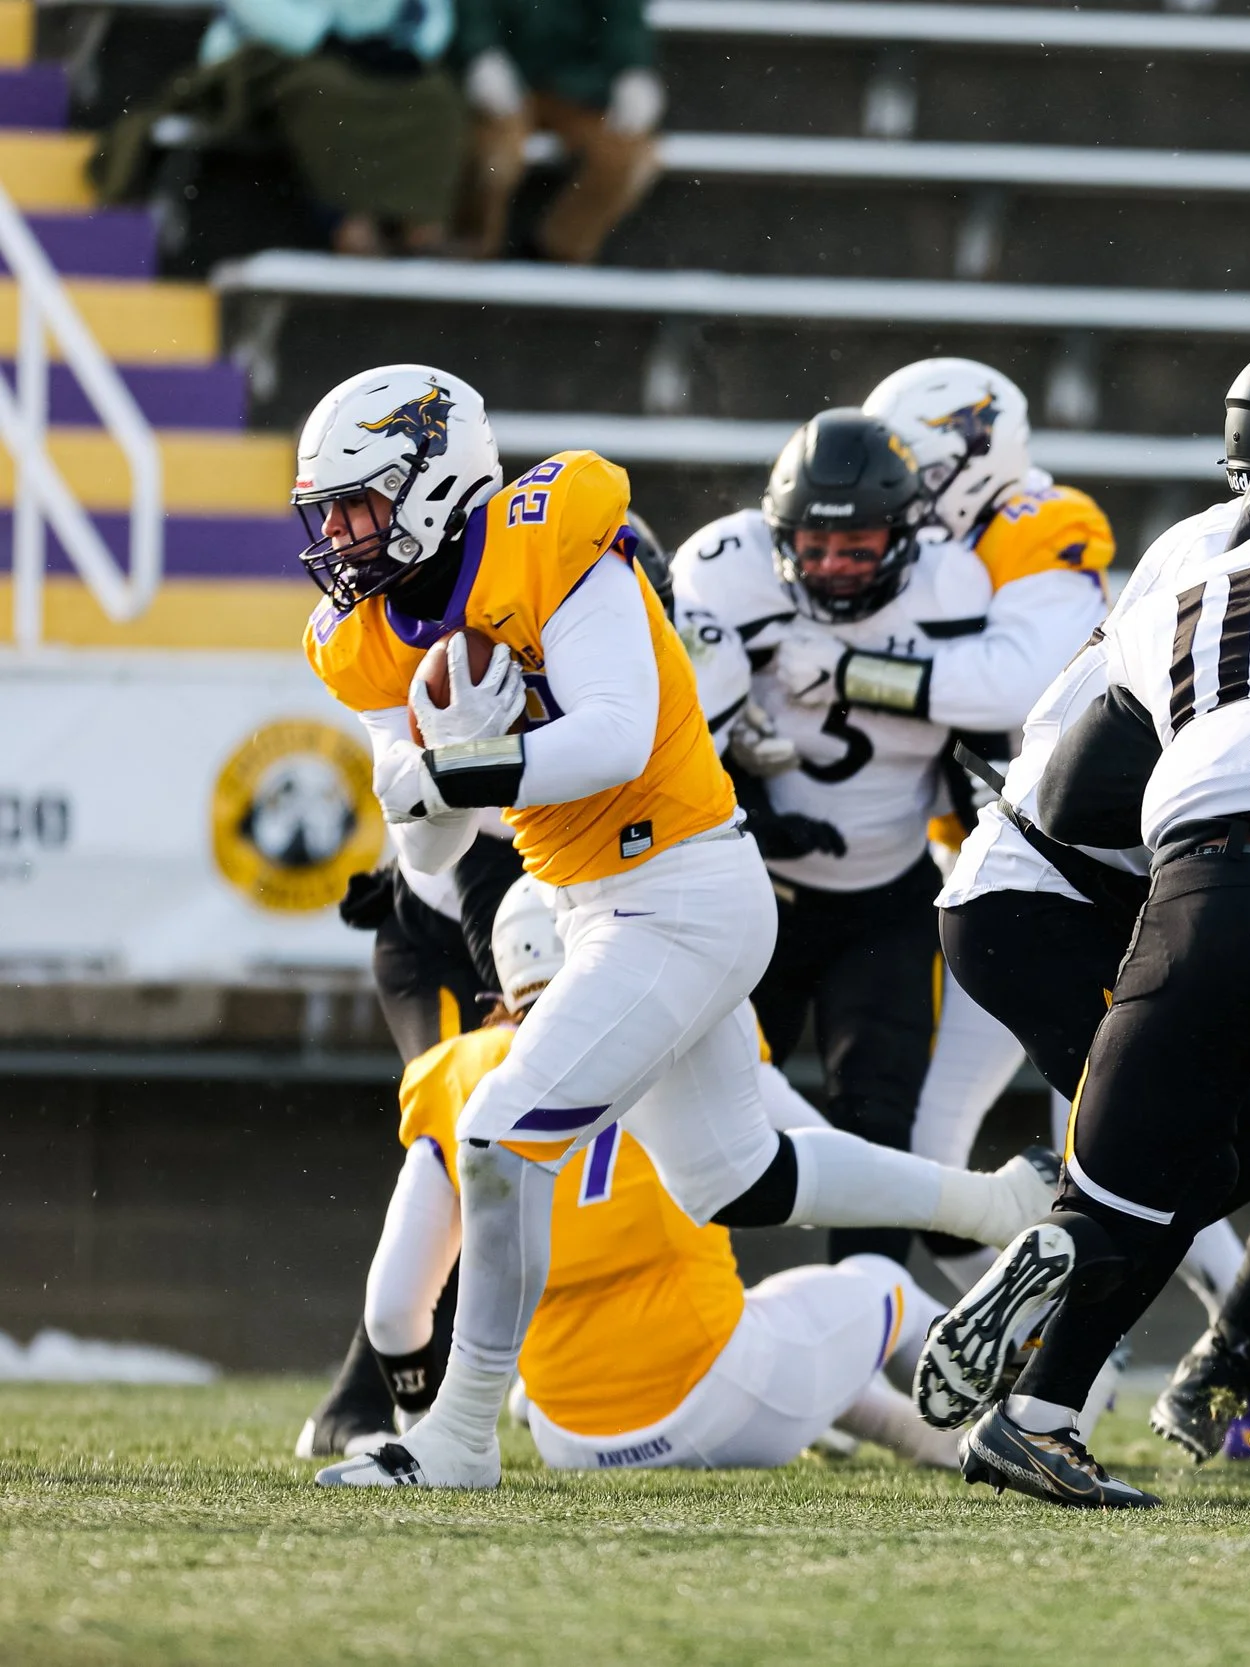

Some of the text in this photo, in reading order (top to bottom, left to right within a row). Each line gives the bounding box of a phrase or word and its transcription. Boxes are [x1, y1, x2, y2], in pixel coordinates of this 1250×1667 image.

[507, 460, 566, 527] 28
[698, 536, 741, 561] 5
[631, 828, 640, 838] L
[596, 1436, 672, 1467] MAVERICKS
